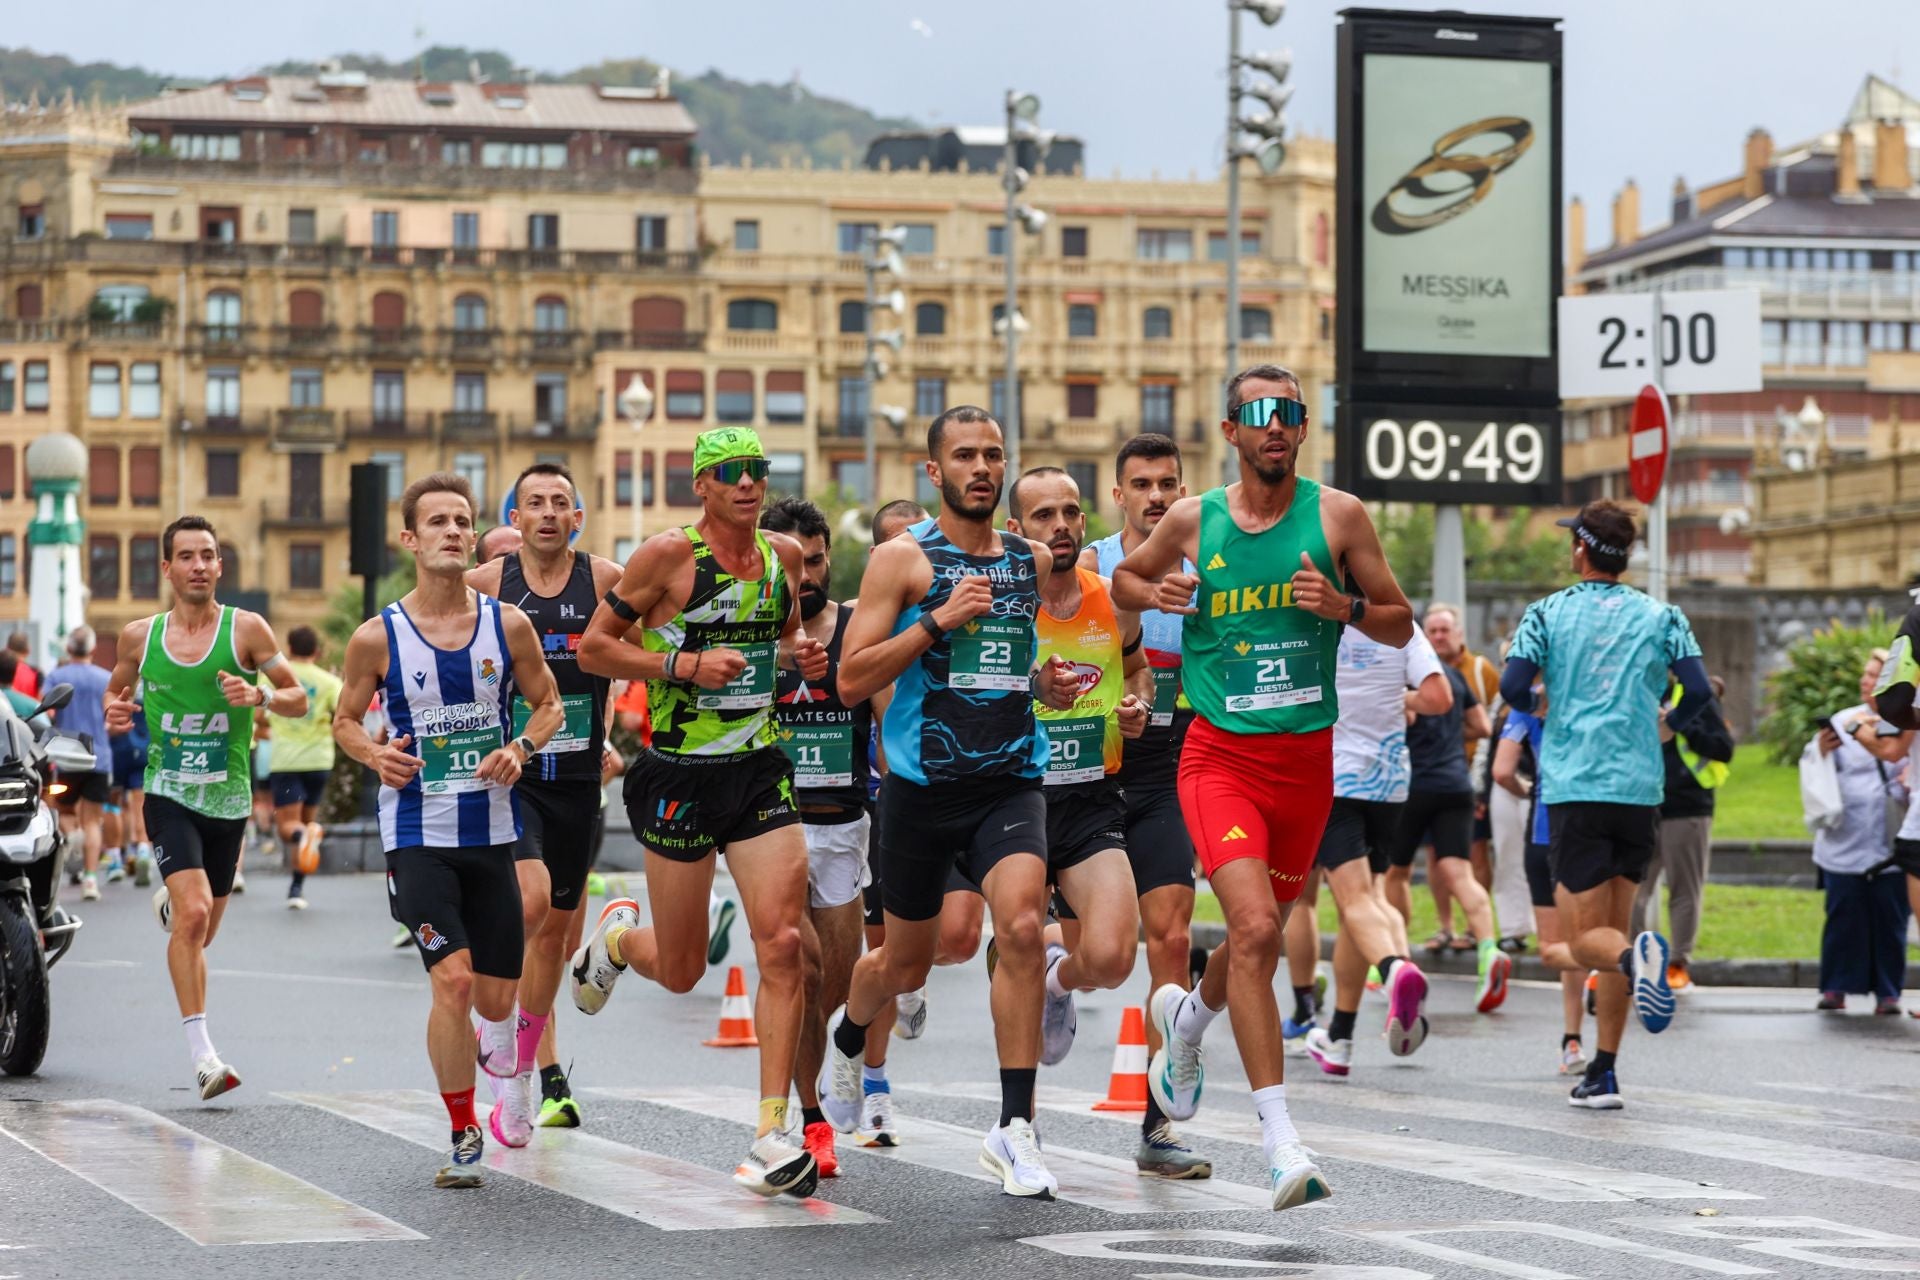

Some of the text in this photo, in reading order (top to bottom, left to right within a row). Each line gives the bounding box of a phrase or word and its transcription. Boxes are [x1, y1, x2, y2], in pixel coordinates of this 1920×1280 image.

[1402, 274, 1510, 298] MESSIKA
[1597, 312, 1717, 370] 2:00
[1365, 419, 1544, 485] 09:49
[1210, 582, 1298, 618] BIKIL
[983, 625, 1024, 634] RURAL KUTXA
[1078, 633, 1111, 643] SERRANO
[979, 641, 1012, 664] 23
[1254, 640, 1309, 652] RURAL KUTXA
[727, 665, 756, 686] 2
[979, 666, 1011, 674] MOUNIM
[1256, 658, 1290, 683] 21
[1254, 683, 1293, 693] CUESTAS
[421, 701, 494, 721] GIPUZKOA
[1081, 699, 1103, 709] CORRE
[161, 713, 229, 734] LEA
[426, 716, 491, 735] KIROLAK
[776, 711, 852, 722] ALATEGUI
[1048, 723, 1096, 733] RURAL KUTXA
[450, 733, 494, 746] RURAL KUTXA
[181, 751, 209, 768] 24
[797, 745, 824, 766] 11
[1050, 739, 1080, 761] 20
[448, 750, 481, 771] 10
[1050, 762, 1077, 770] BOSSY
[662, 837, 685, 849] WITH
